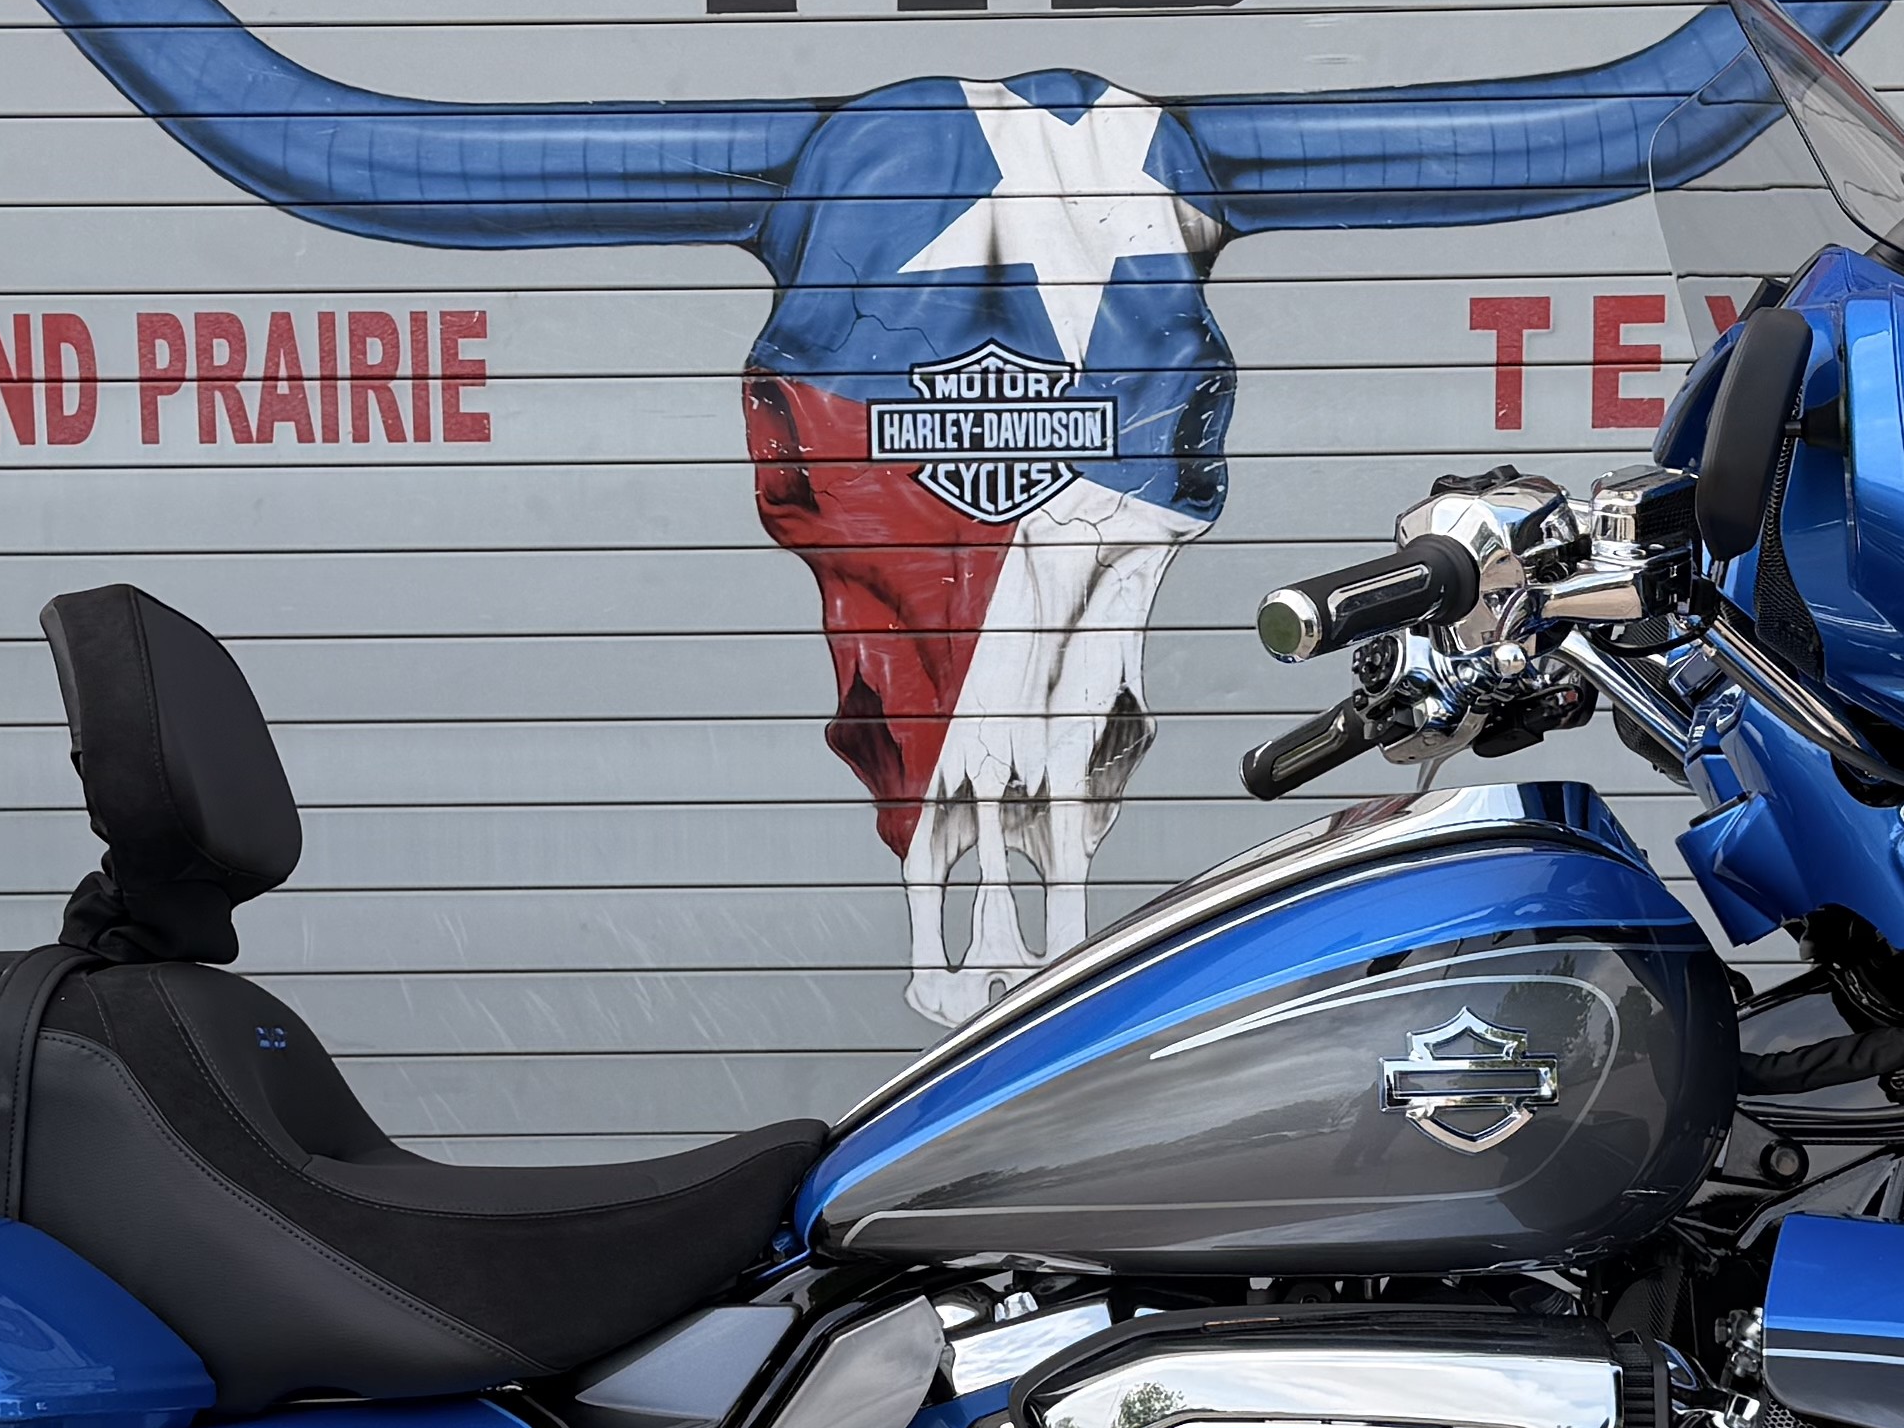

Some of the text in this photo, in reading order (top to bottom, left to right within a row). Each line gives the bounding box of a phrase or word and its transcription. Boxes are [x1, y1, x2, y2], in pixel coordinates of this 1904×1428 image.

[137, 310, 492, 444] PRAIRIE
[1469, 294, 1739, 431] TE
[935, 356, 1050, 399] MOTOR
[883, 410, 1102, 449] HARLEY-DAVIDSON
[937, 461, 1052, 513] CYCLES
